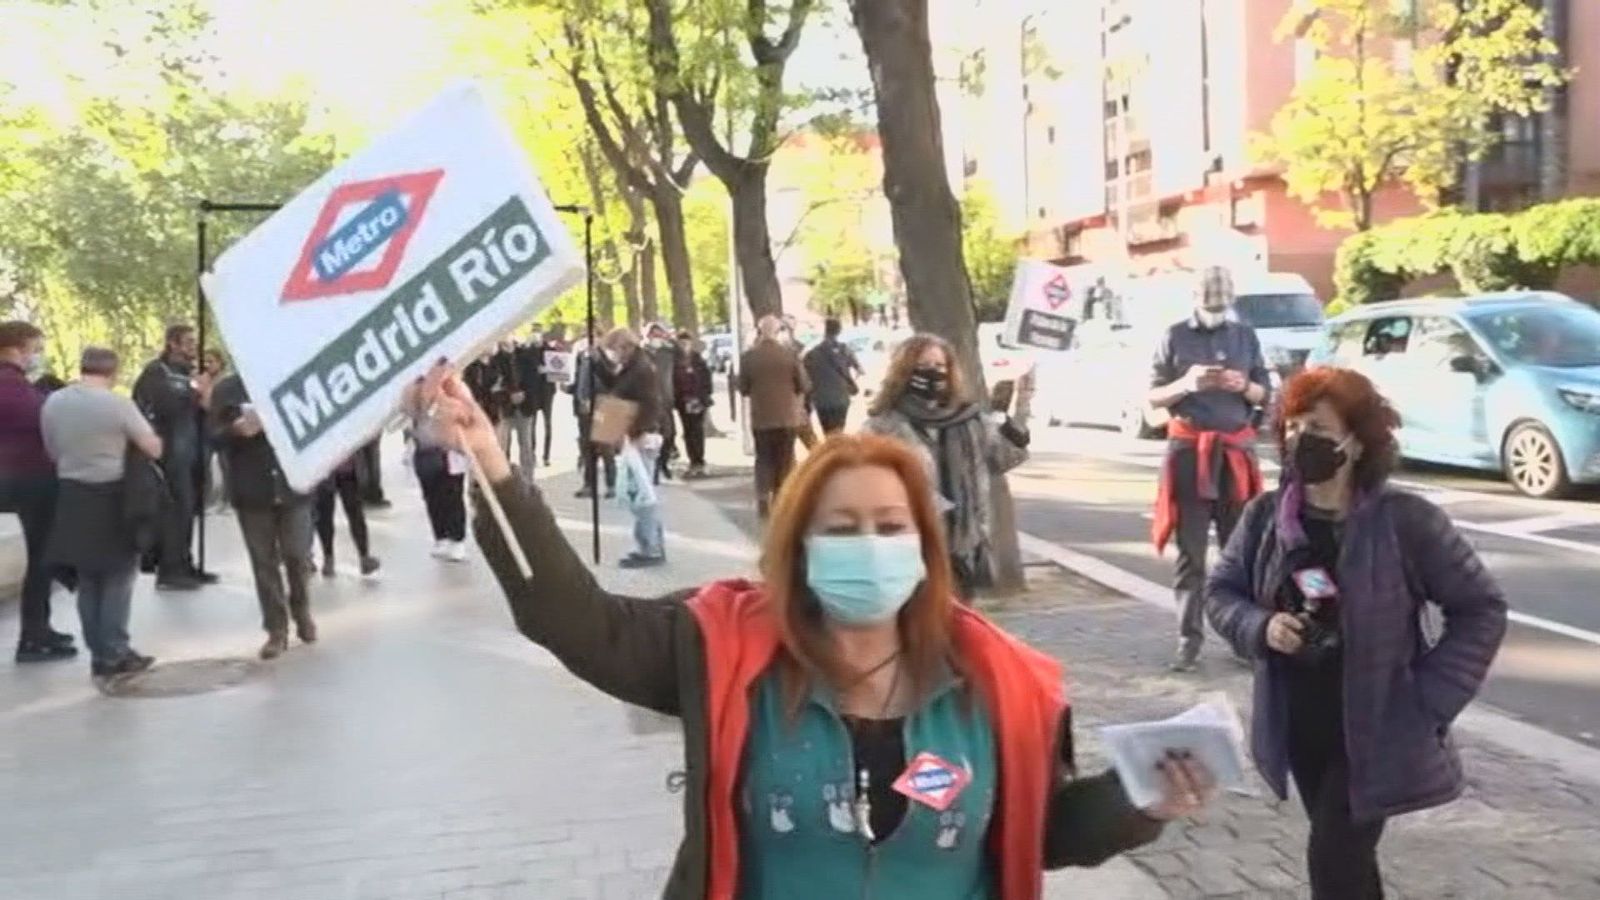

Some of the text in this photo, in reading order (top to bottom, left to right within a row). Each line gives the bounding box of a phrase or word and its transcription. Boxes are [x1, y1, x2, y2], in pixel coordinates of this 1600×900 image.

[320, 205, 399, 274] Metro
[280, 223, 537, 439] Madrid Río
